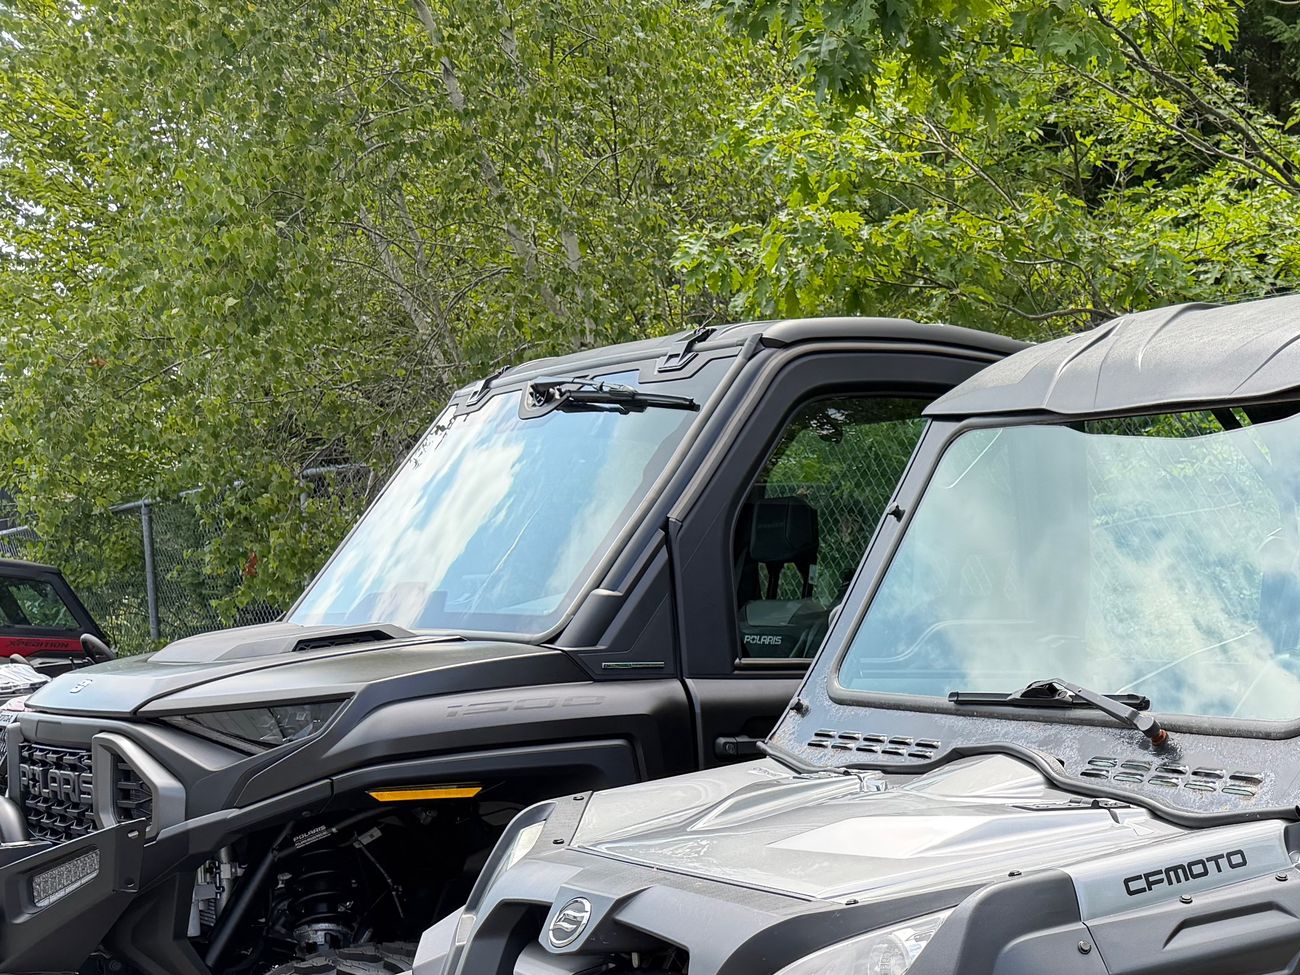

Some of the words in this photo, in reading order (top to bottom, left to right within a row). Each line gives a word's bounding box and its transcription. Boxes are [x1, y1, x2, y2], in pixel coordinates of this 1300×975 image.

[743, 635, 782, 645] POLARIS
[20, 763, 93, 804] POLARIS
[1123, 849, 1248, 896] CFMOTO
